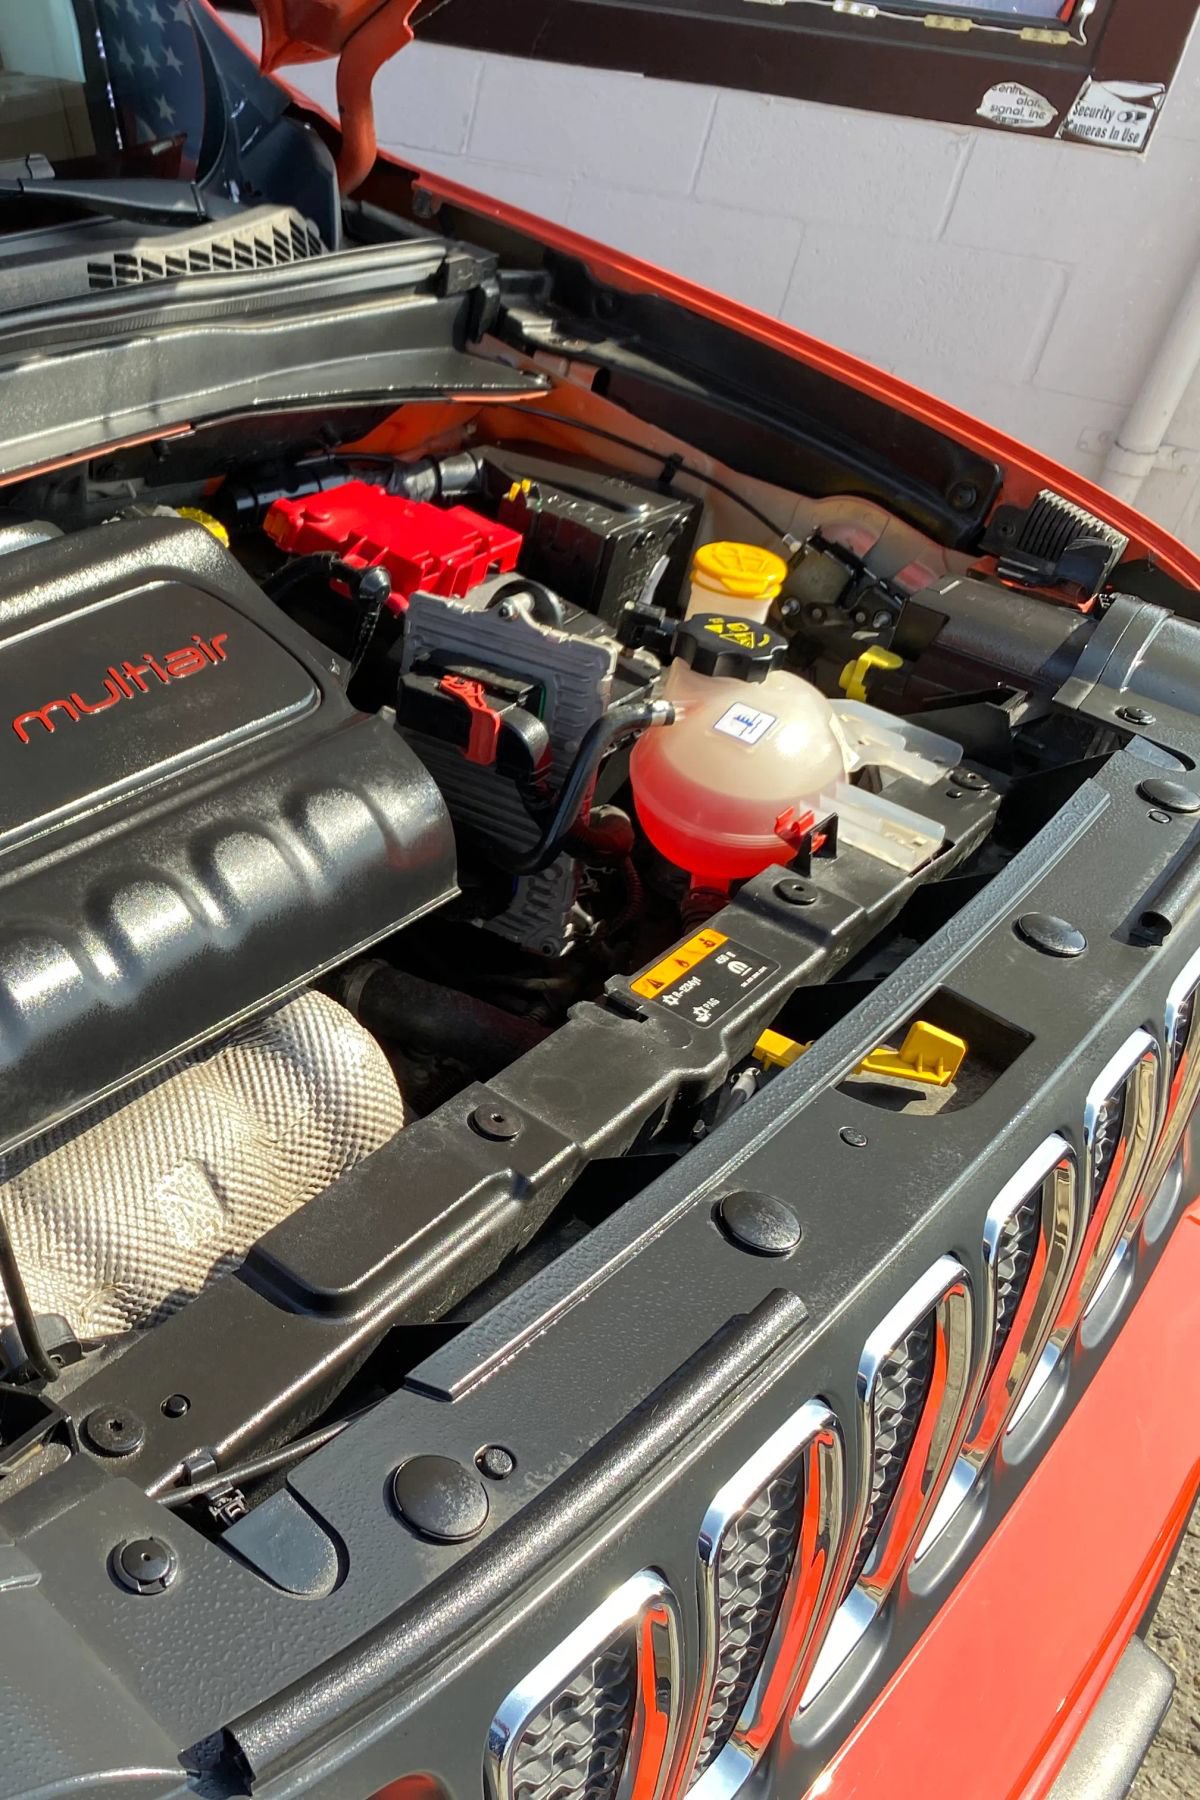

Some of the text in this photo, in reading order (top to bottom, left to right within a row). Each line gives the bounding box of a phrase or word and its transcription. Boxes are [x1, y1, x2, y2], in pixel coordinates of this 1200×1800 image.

[1016, 96, 1041, 108] alar
[1072, 101, 1116, 124] Security
[1109, 125, 1120, 141] In
[1121, 127, 1140, 144] Use
[11, 632, 228, 744] multiair
